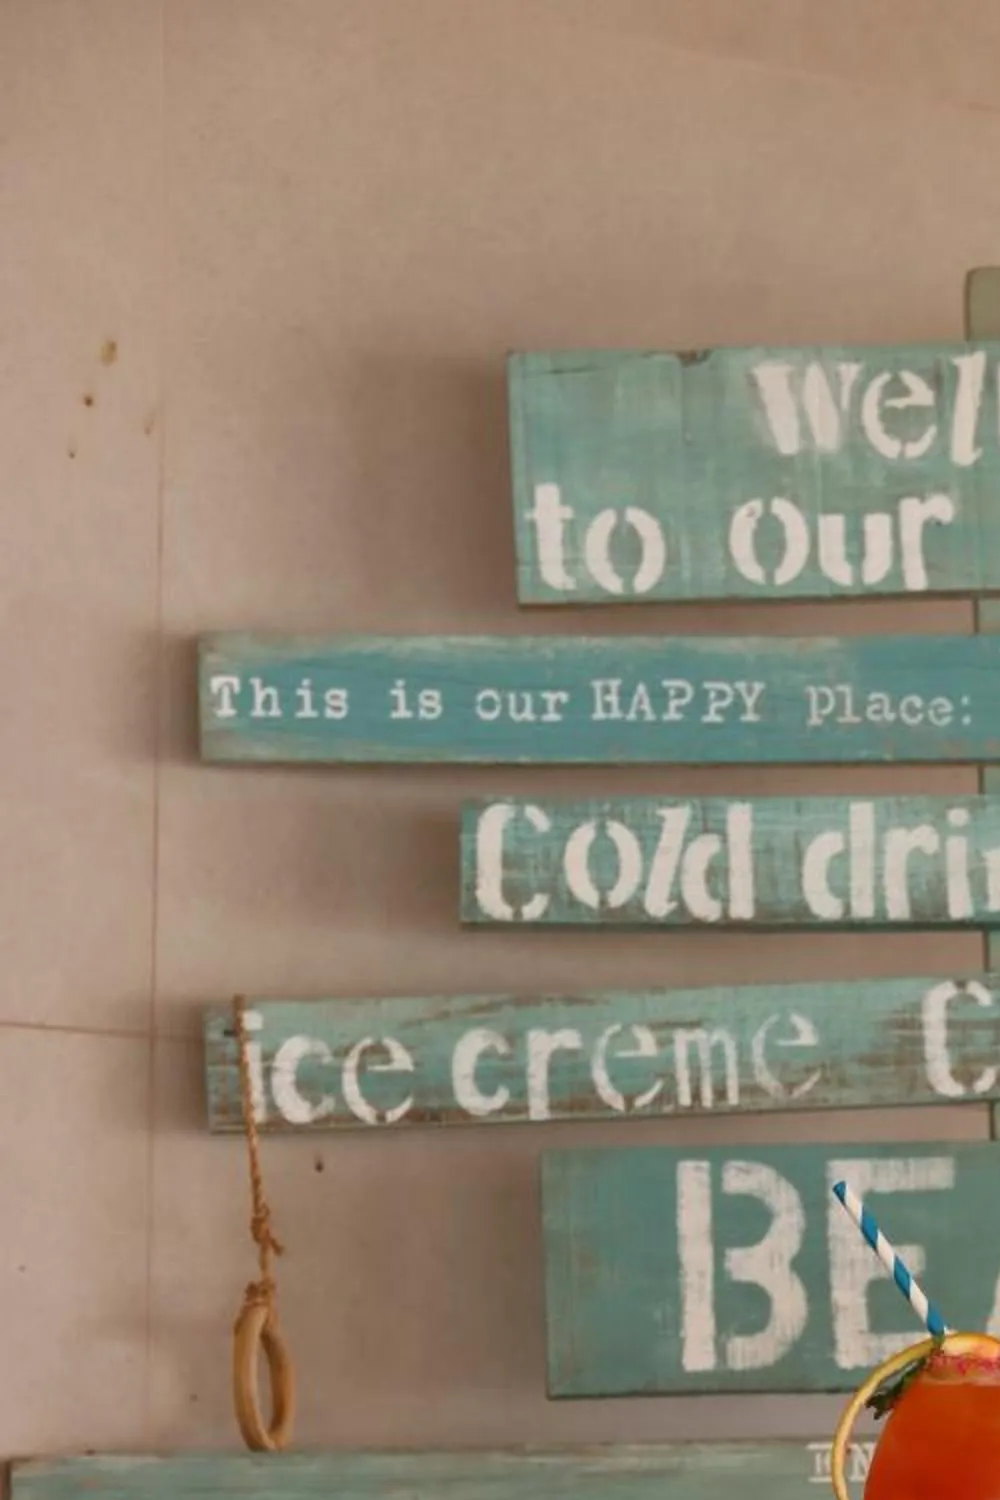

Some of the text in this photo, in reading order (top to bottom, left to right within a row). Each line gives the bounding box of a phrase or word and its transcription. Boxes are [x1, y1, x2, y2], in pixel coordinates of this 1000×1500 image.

[524, 482, 666, 594] to
[729, 494, 955, 589] our
[210, 674, 351, 718] This
[389, 678, 445, 719] is
[474, 688, 571, 724] our
[592, 680, 766, 725] HAPPY
[474, 802, 756, 922] Cold
[242, 1009, 416, 1126] ice
[450, 1010, 822, 1120] creme
